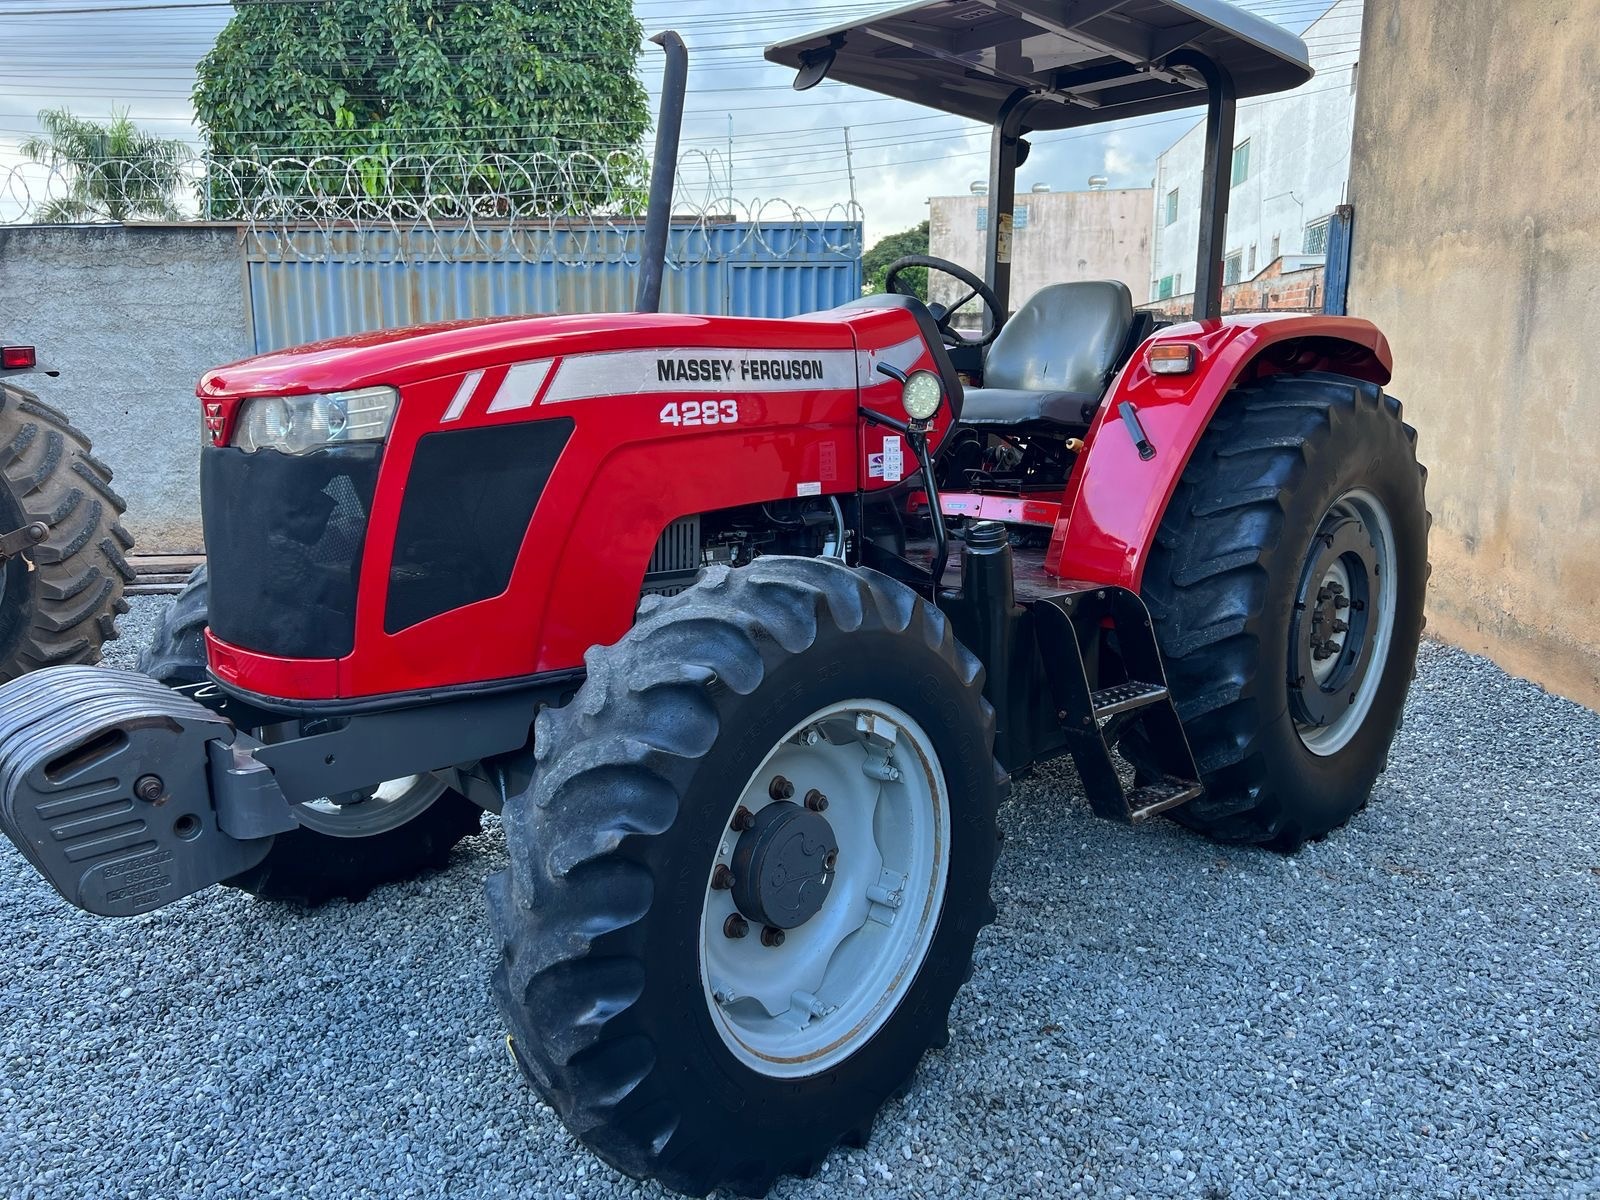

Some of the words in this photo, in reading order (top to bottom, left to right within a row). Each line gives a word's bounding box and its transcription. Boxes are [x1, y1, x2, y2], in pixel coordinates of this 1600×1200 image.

[657, 359, 733, 381] MASSEY
[740, 360, 824, 380] FERGUSON
[659, 399, 739, 427] 4283
